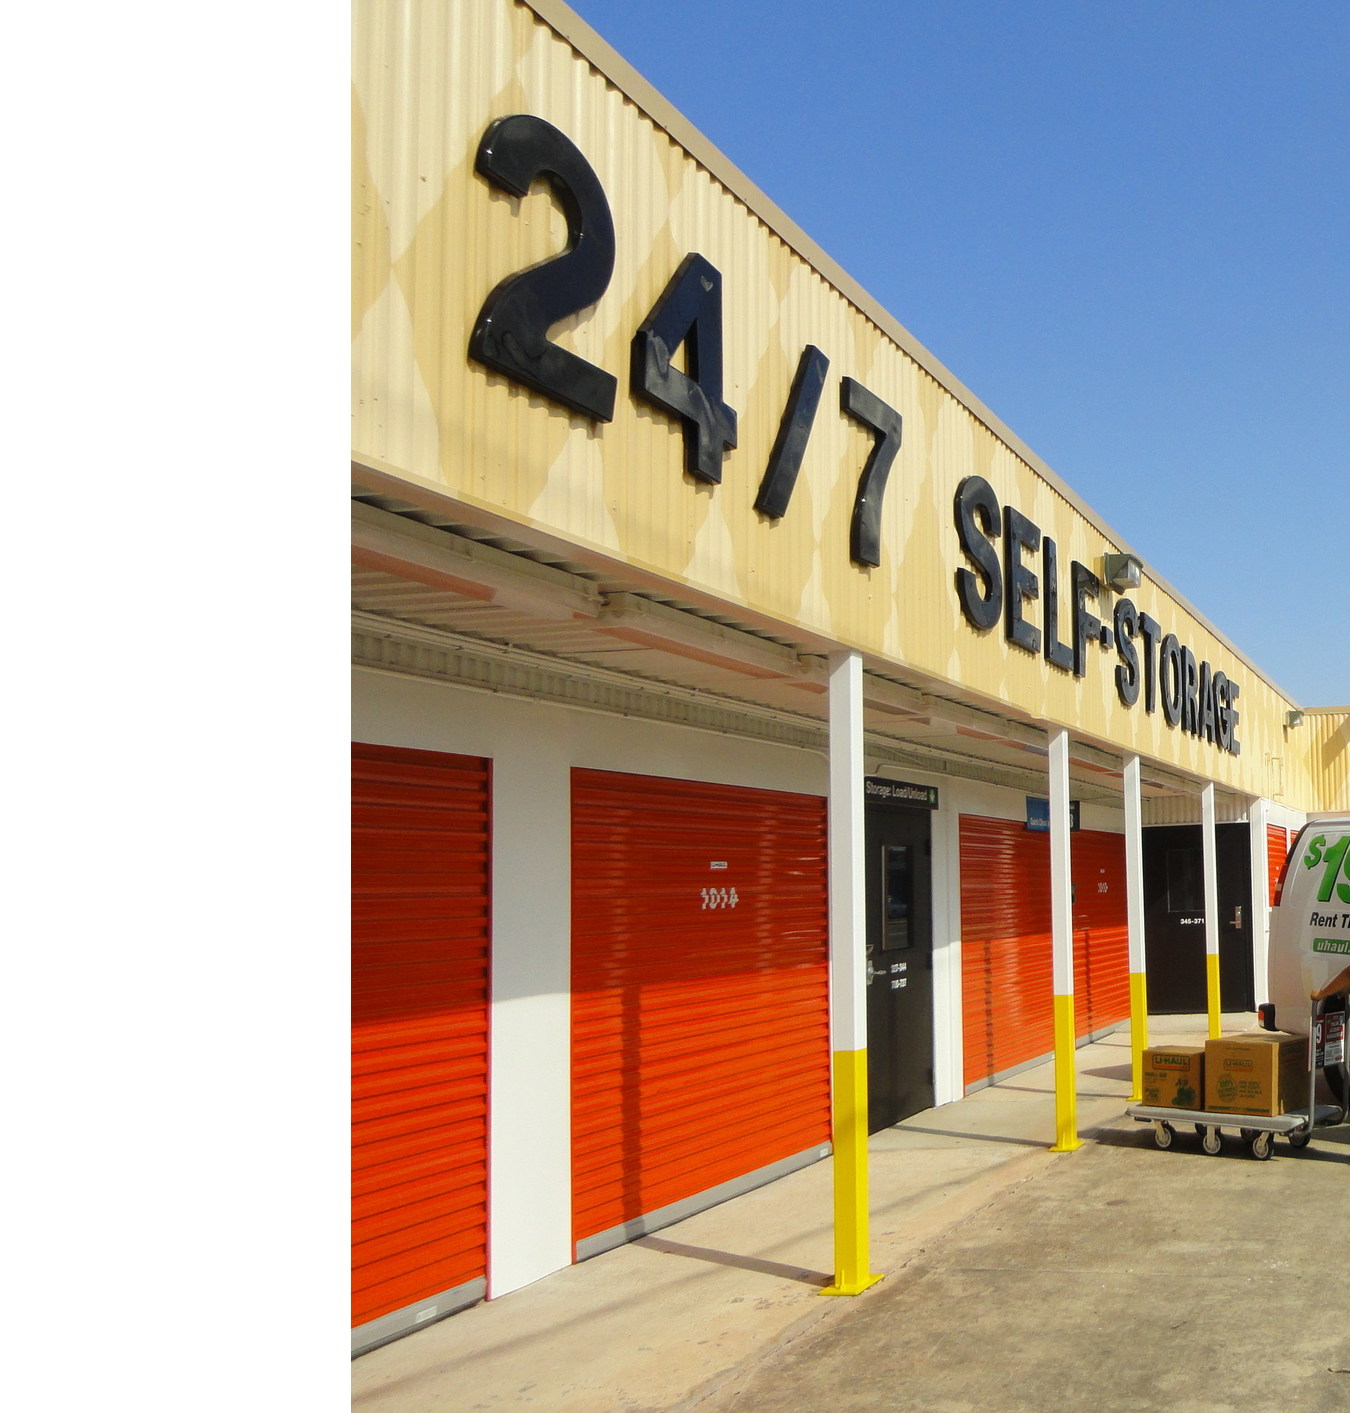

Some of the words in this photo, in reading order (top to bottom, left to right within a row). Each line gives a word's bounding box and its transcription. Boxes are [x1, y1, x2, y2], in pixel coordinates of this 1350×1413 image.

[468, 114, 904, 568] 24/7
[866, 781, 891, 798] Storage:
[892, 785, 928, 800] Load/Unload
[1180, 917, 1205, 925] 345-371
[1309, 912, 1338, 927] Rent
[1154, 1056, 1188, 1065] U-HAUL
